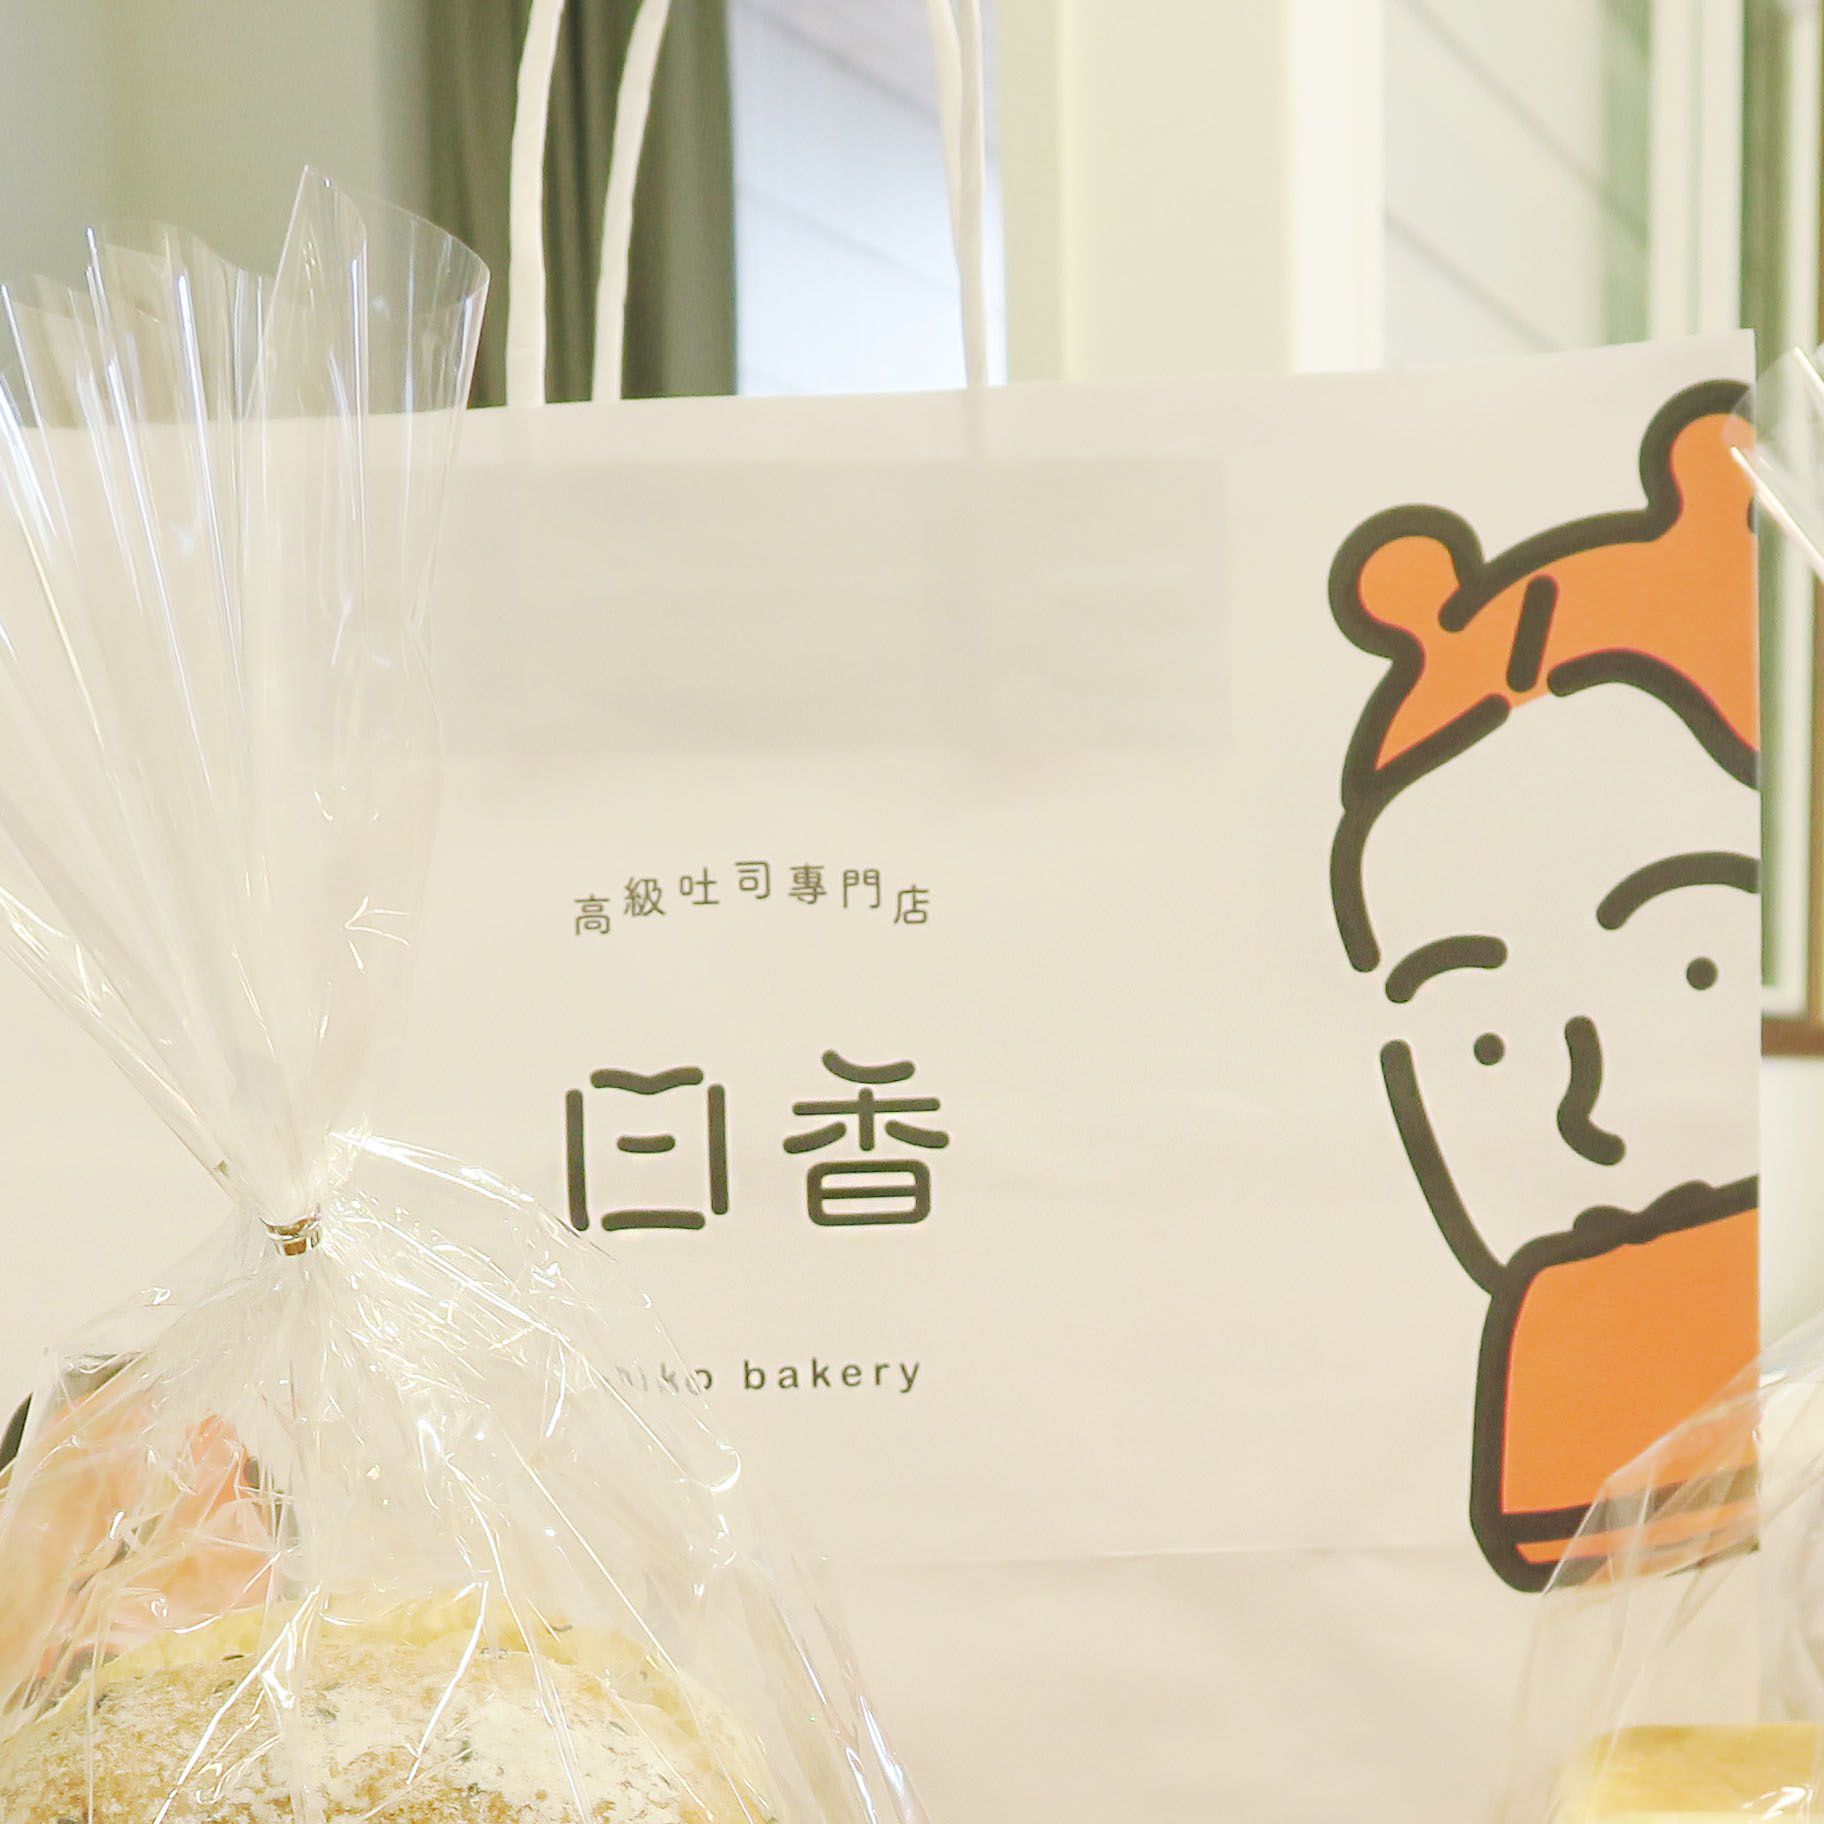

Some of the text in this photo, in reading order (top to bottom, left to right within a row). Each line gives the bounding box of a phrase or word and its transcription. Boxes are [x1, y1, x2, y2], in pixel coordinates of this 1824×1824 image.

[574, 859, 930, 936] 高級吐司專門店
[565, 1048, 951, 1232] 日香
[743, 1356, 922, 1395] bakery
